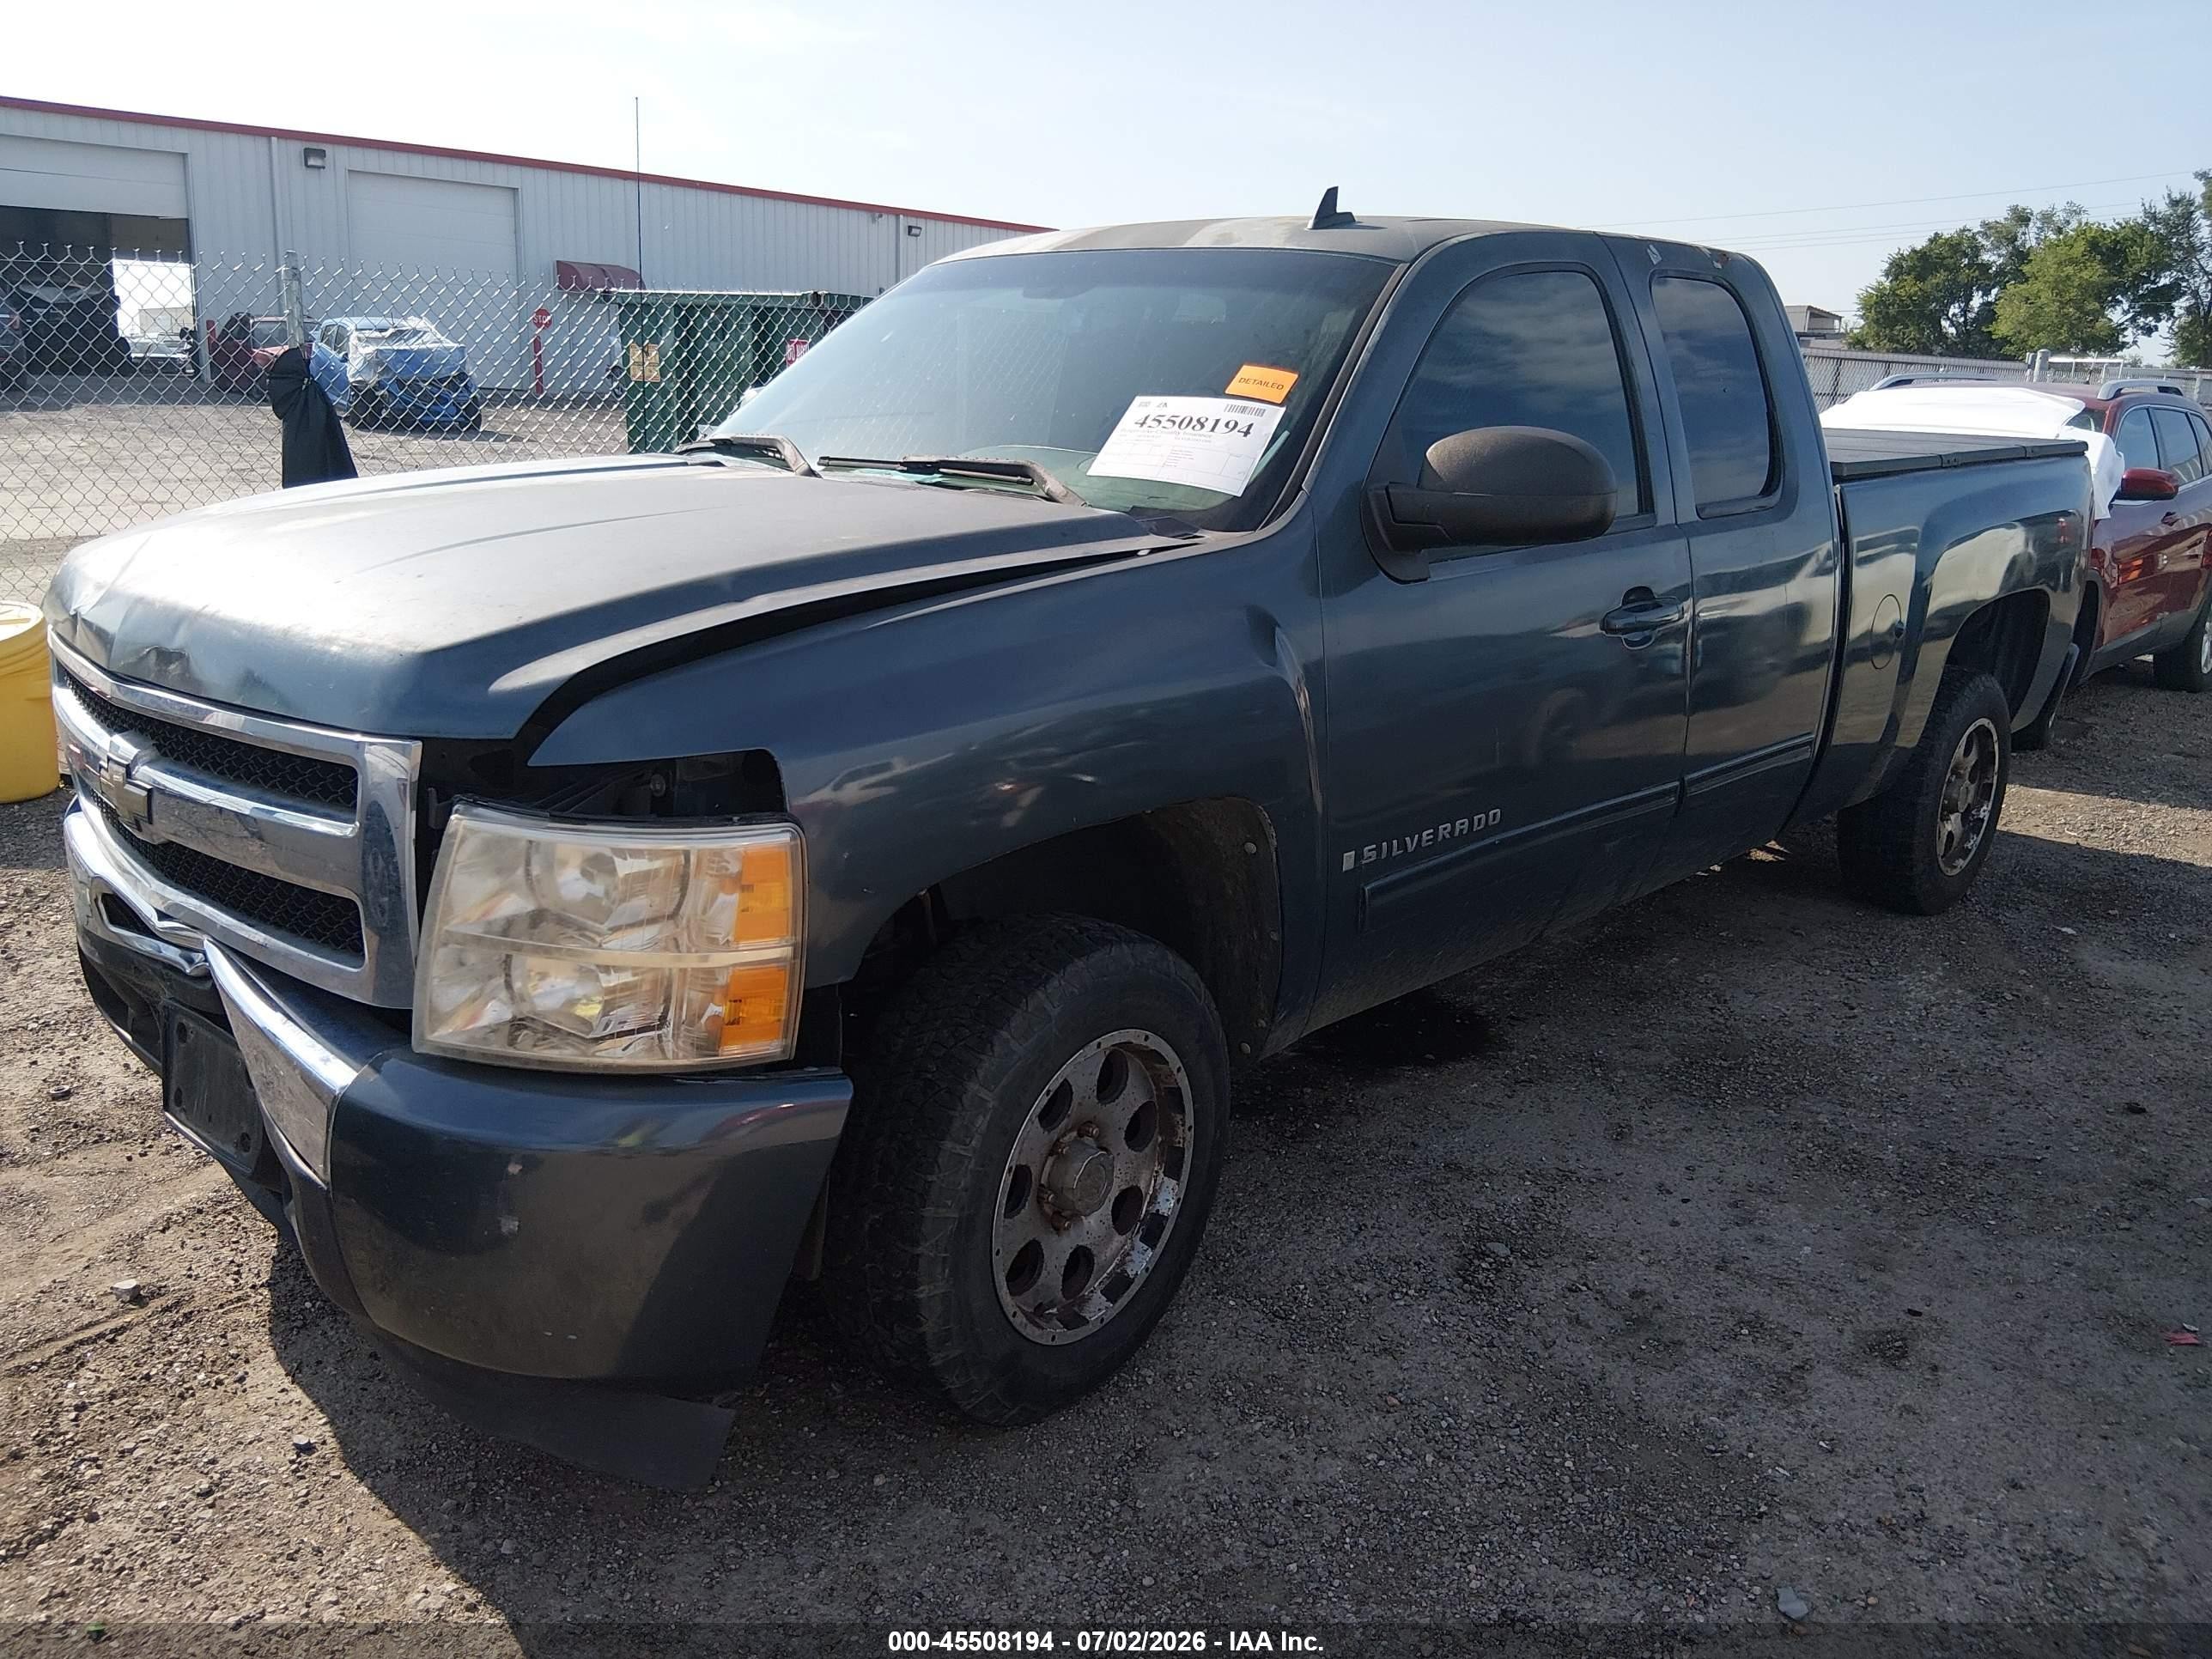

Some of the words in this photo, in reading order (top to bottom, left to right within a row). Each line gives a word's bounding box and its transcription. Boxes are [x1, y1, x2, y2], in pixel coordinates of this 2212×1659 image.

[1238, 376, 1284, 391] DETAILED
[1133, 414, 1255, 438] 45508194
[1360, 808, 1501, 865] SILVERADO
